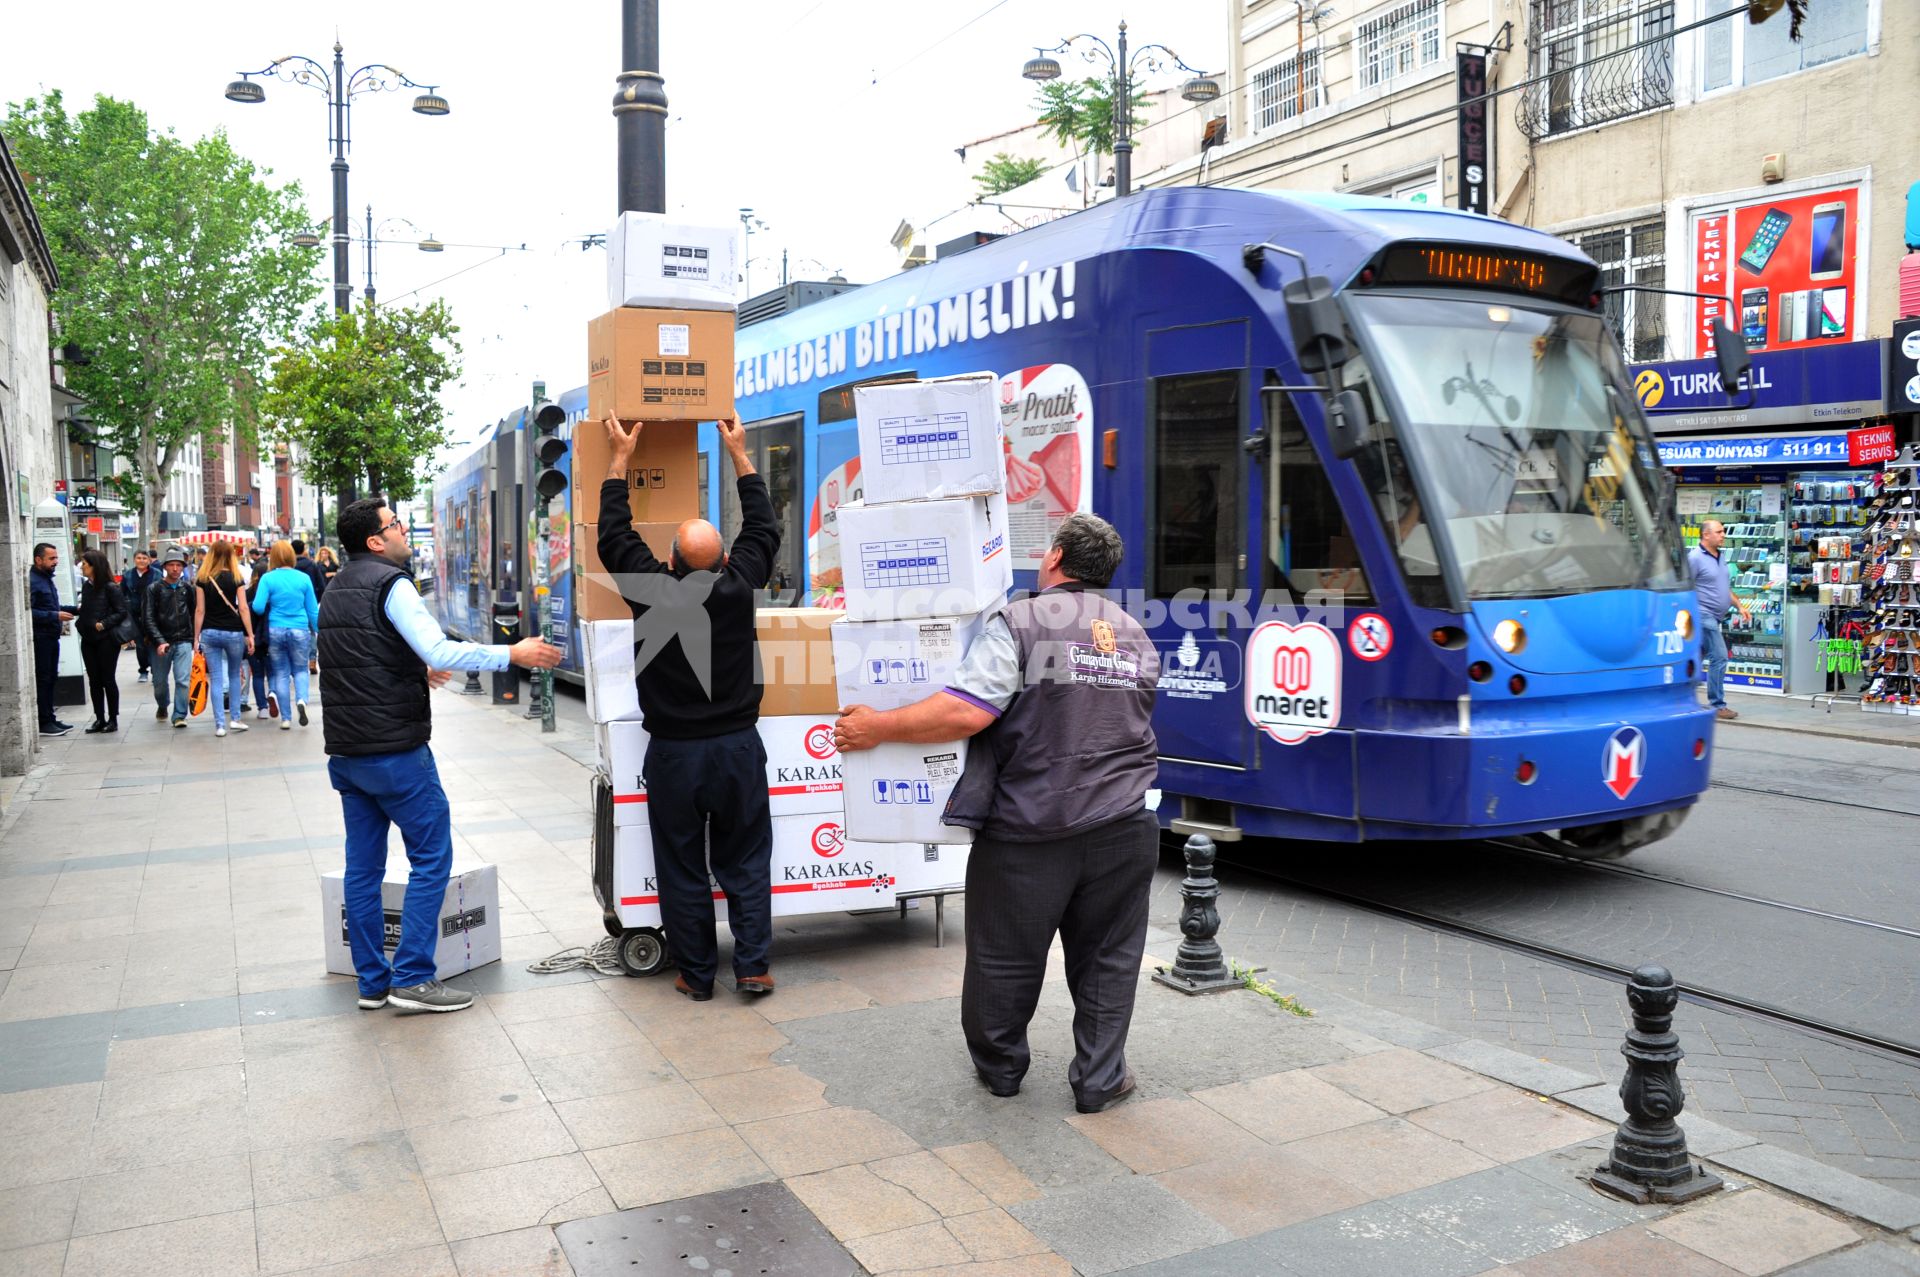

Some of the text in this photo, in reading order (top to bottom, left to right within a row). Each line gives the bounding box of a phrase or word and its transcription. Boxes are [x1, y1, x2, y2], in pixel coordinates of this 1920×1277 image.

[855, 260, 1076, 368] BİTİRMELİK!
[1670, 366, 1772, 396] TURKELL
[1023, 384, 1076, 421] Pratik
[1705, 444, 1769, 459] DÜNYASI
[1782, 442, 1809, 456] 511
[1810, 441, 1831, 455] 91
[1857, 431, 1892, 447] TEKNİK
[1858, 445, 1893, 462] SERVİS
[1113, 651, 1138, 677] Group
[1070, 671, 1138, 689] Kargo Hizmetleri
[1256, 694, 1329, 719] maret
[783, 860, 874, 881] KARAKAŞ
